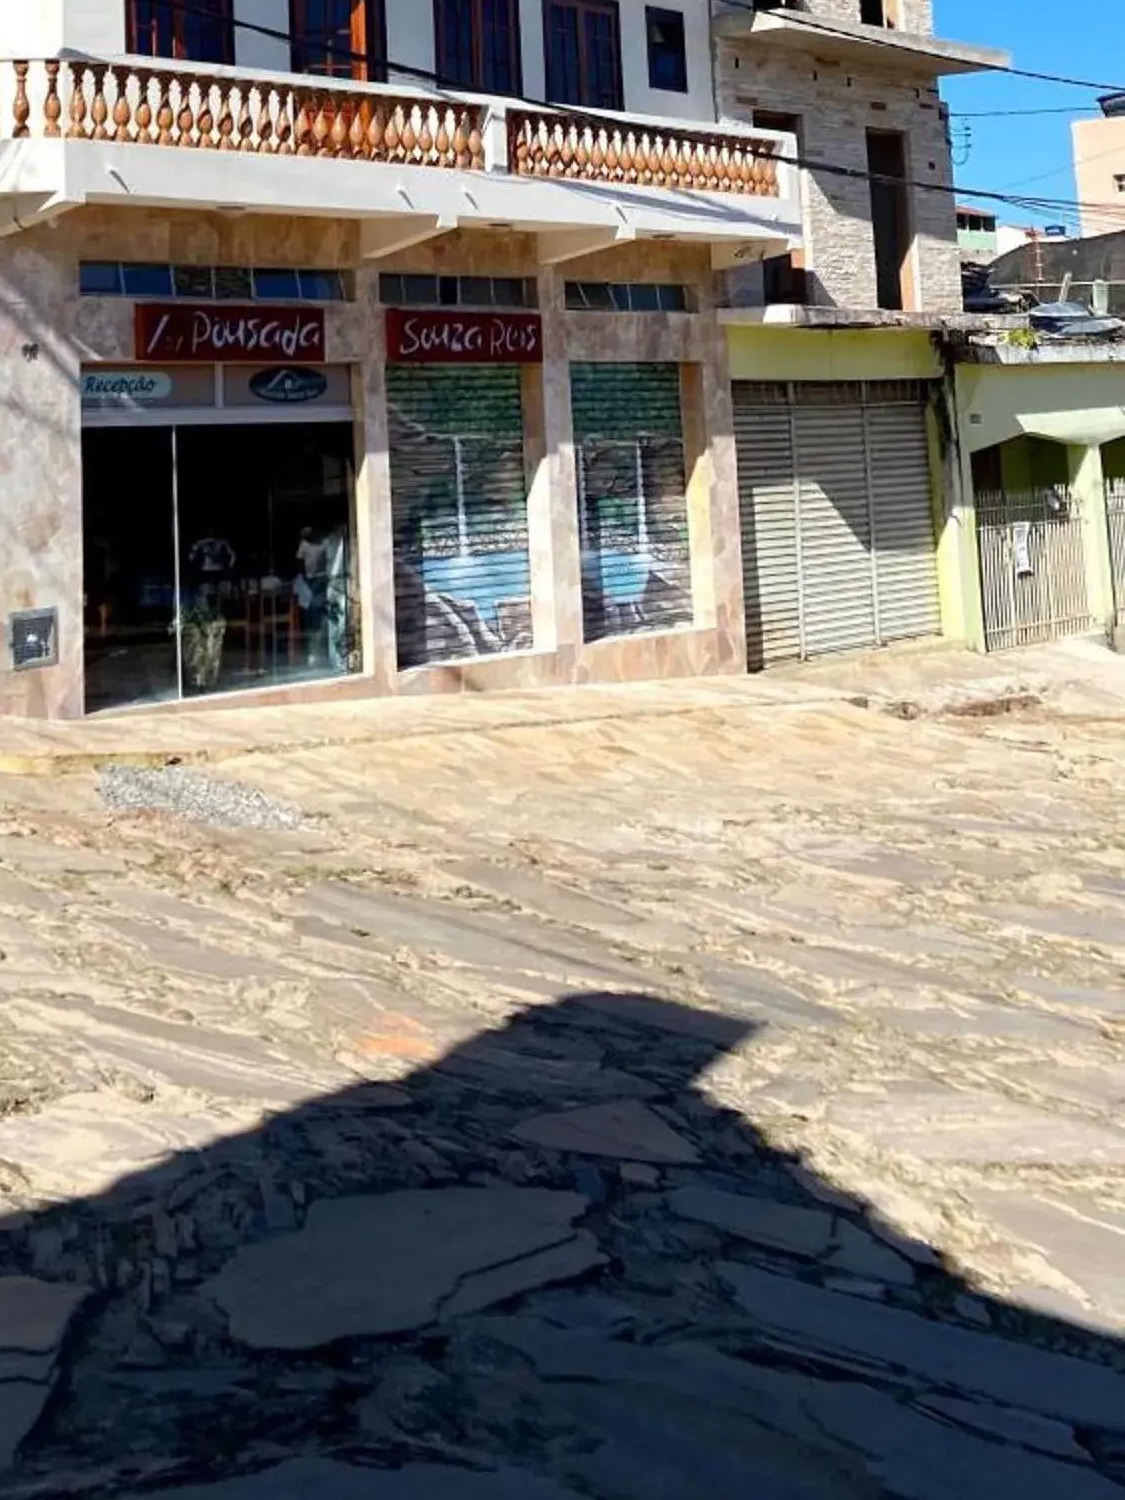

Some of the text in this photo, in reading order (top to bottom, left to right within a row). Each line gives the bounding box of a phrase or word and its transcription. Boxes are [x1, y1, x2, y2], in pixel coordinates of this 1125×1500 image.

[192, 310, 537, 356] Pousada Souza Reis
